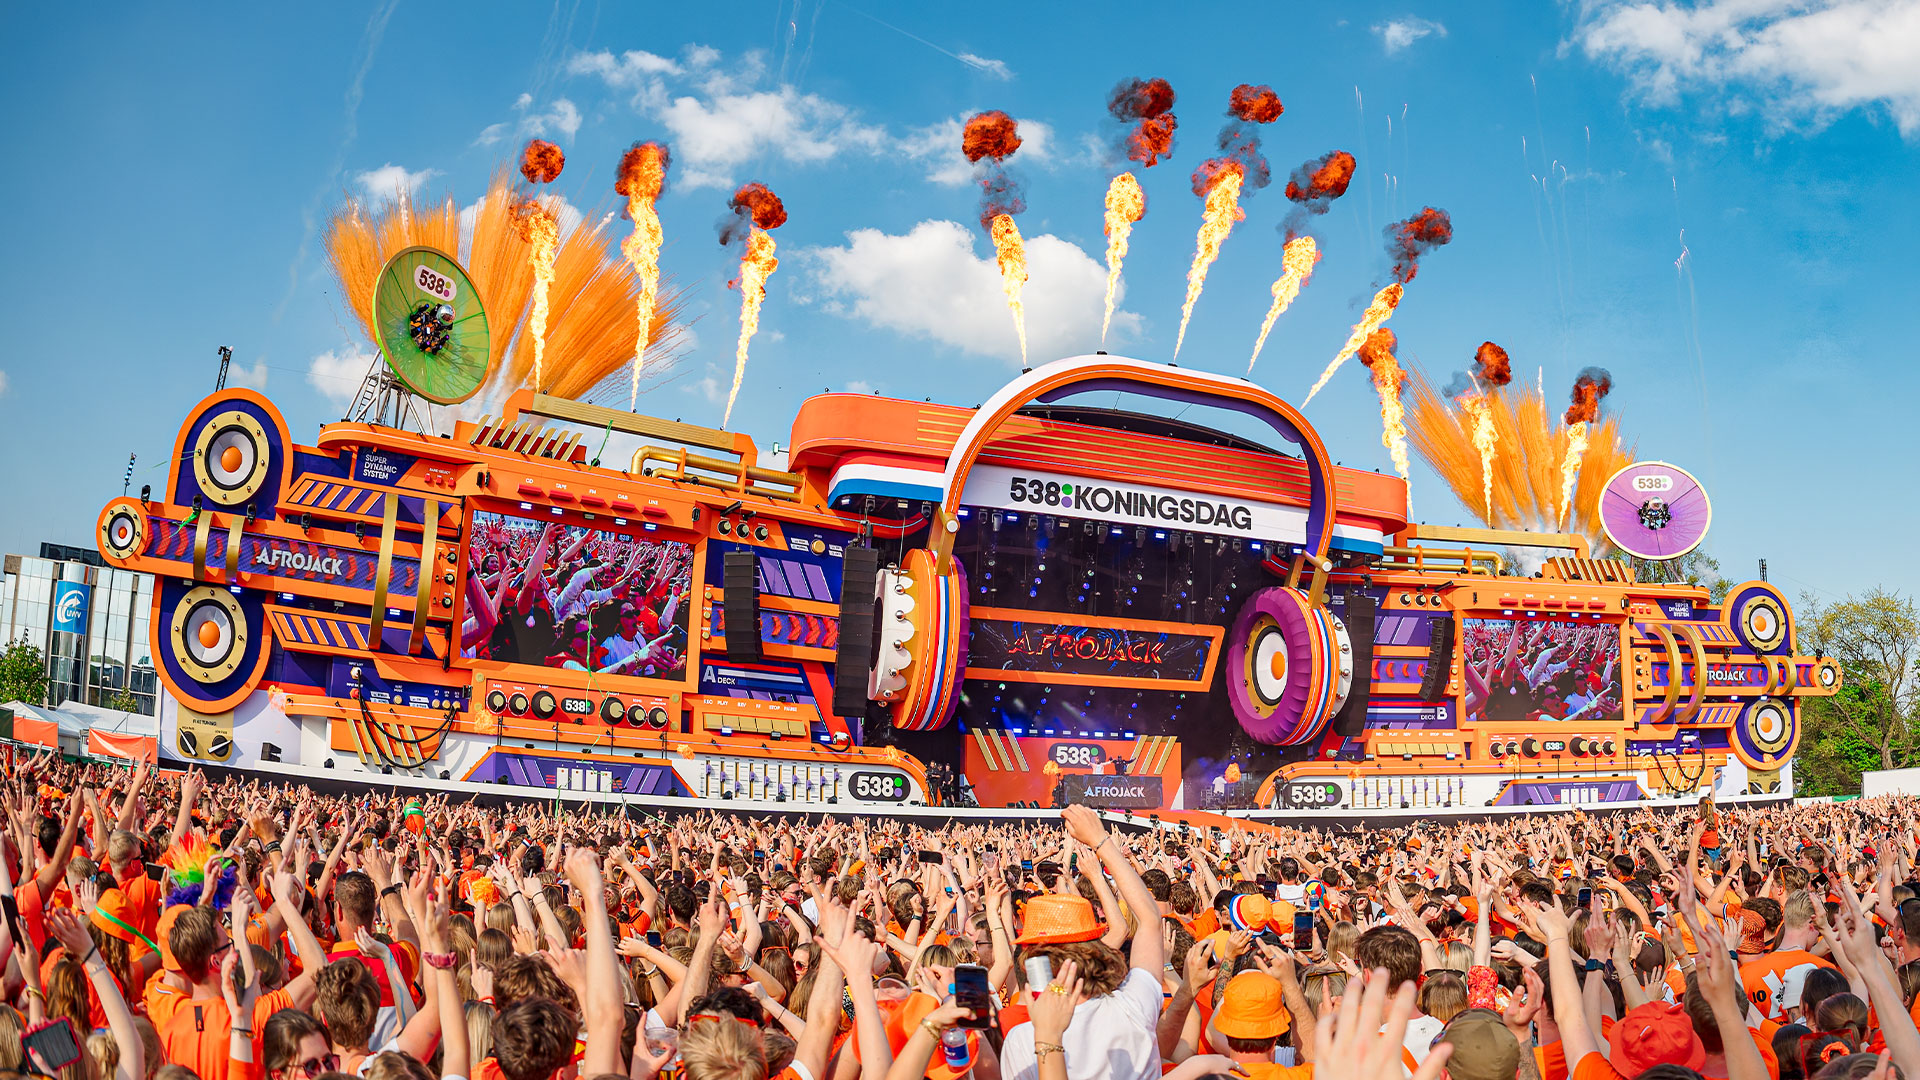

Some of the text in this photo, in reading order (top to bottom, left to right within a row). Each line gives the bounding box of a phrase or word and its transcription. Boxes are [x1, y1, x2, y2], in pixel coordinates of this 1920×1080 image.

[419, 269, 445, 294] 538
[365, 454, 387, 464] SUPER
[362, 469, 389, 480] SYSTEM
[364, 461, 397, 474] DYNAMIC
[1638, 478, 1661, 489] 538
[256, 546, 344, 576] AFROJACK
[1007, 630, 1165, 664] AFROJACK
[702, 665, 736, 685] A DECK
[565, 699, 585, 712] 538
[1436, 706, 1448, 720] B
[1545, 742, 1560, 750] 538
[1056, 746, 1091, 765] 538
[856, 776, 895, 798] 538
[1084, 785, 1145, 798] AFROJACK
[1291, 785, 1326, 804] 538
